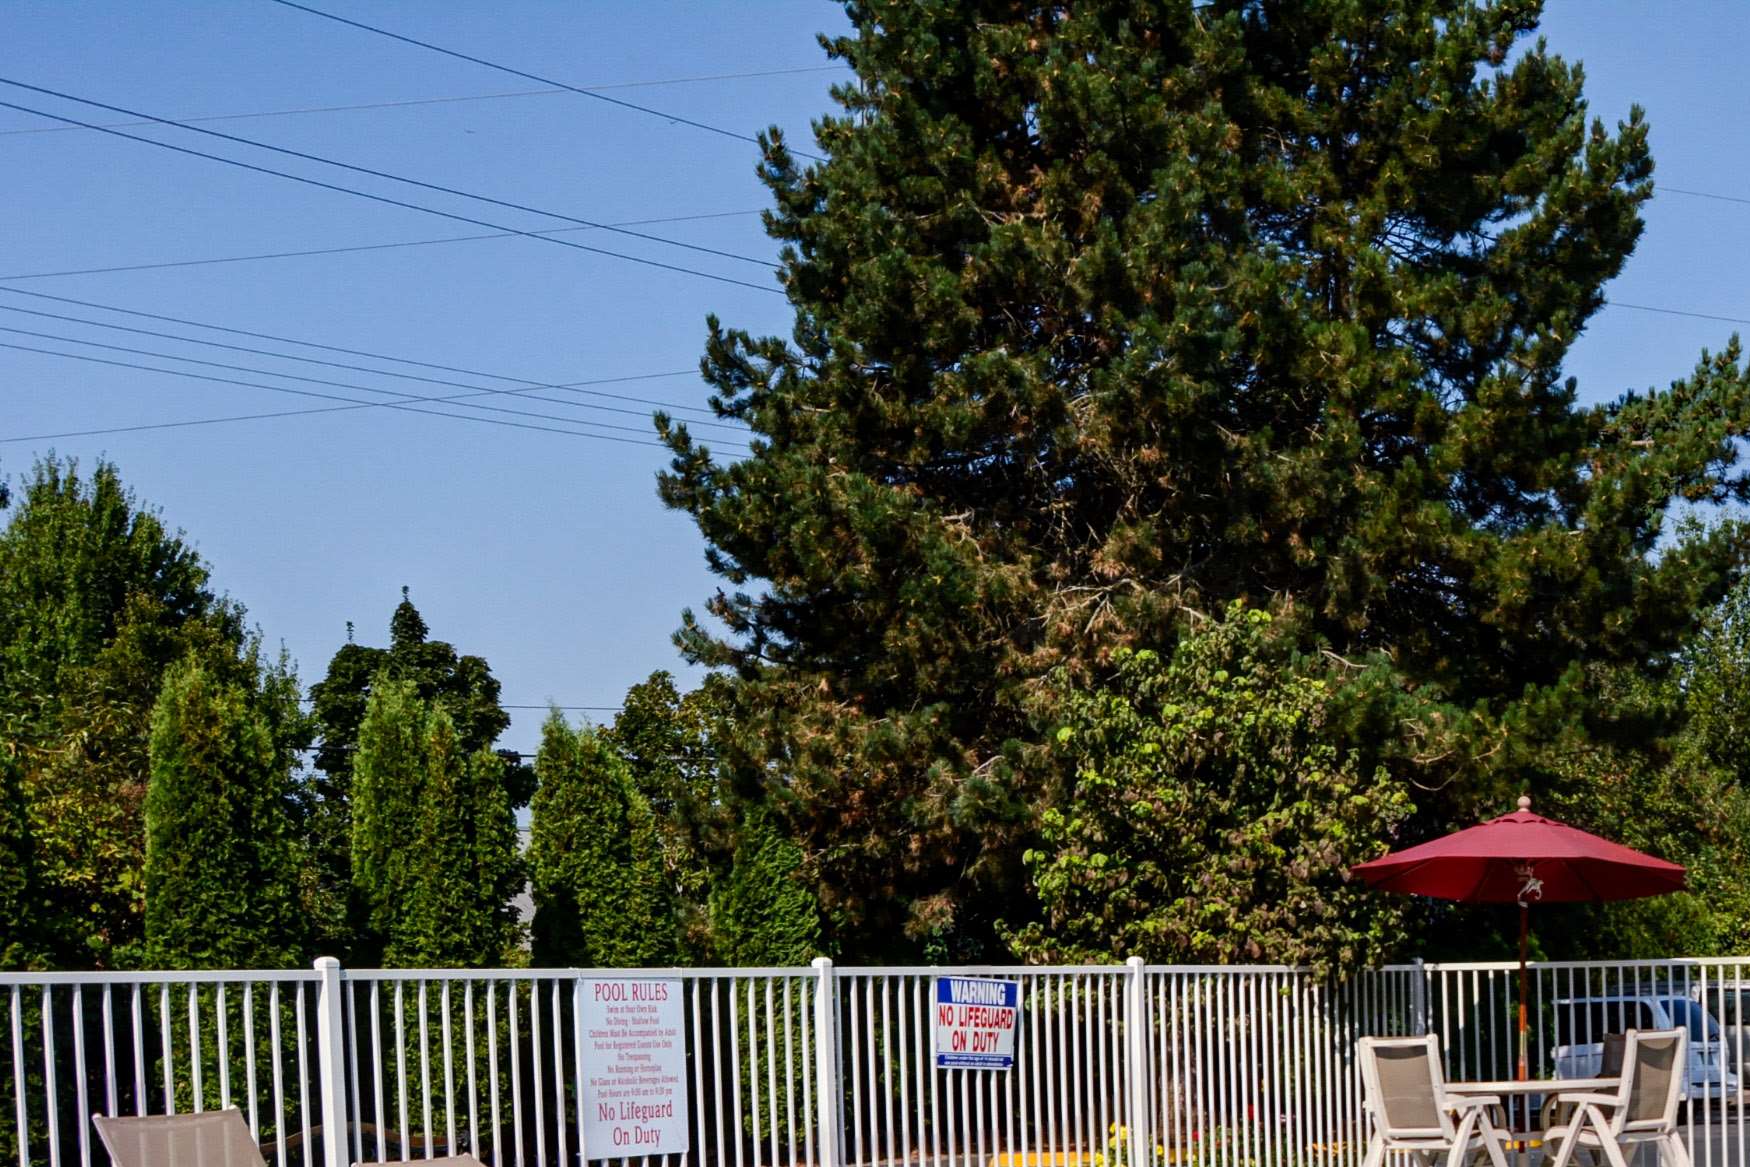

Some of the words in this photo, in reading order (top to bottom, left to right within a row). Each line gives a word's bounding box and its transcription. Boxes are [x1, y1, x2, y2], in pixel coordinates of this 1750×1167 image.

[595, 983, 628, 1001] POOL
[632, 983, 668, 1001] RULES
[950, 980, 1005, 1005] WARNING
[939, 1005, 954, 1026] NO
[959, 1007, 1013, 1029] LIFEGUARD
[952, 1030, 967, 1051] ON
[973, 1032, 1000, 1052] DUTY
[598, 1102, 615, 1121] No
[620, 1100, 672, 1123] Lifeguard
[613, 1127, 629, 1146] On
[635, 1126, 661, 1147] Duty
